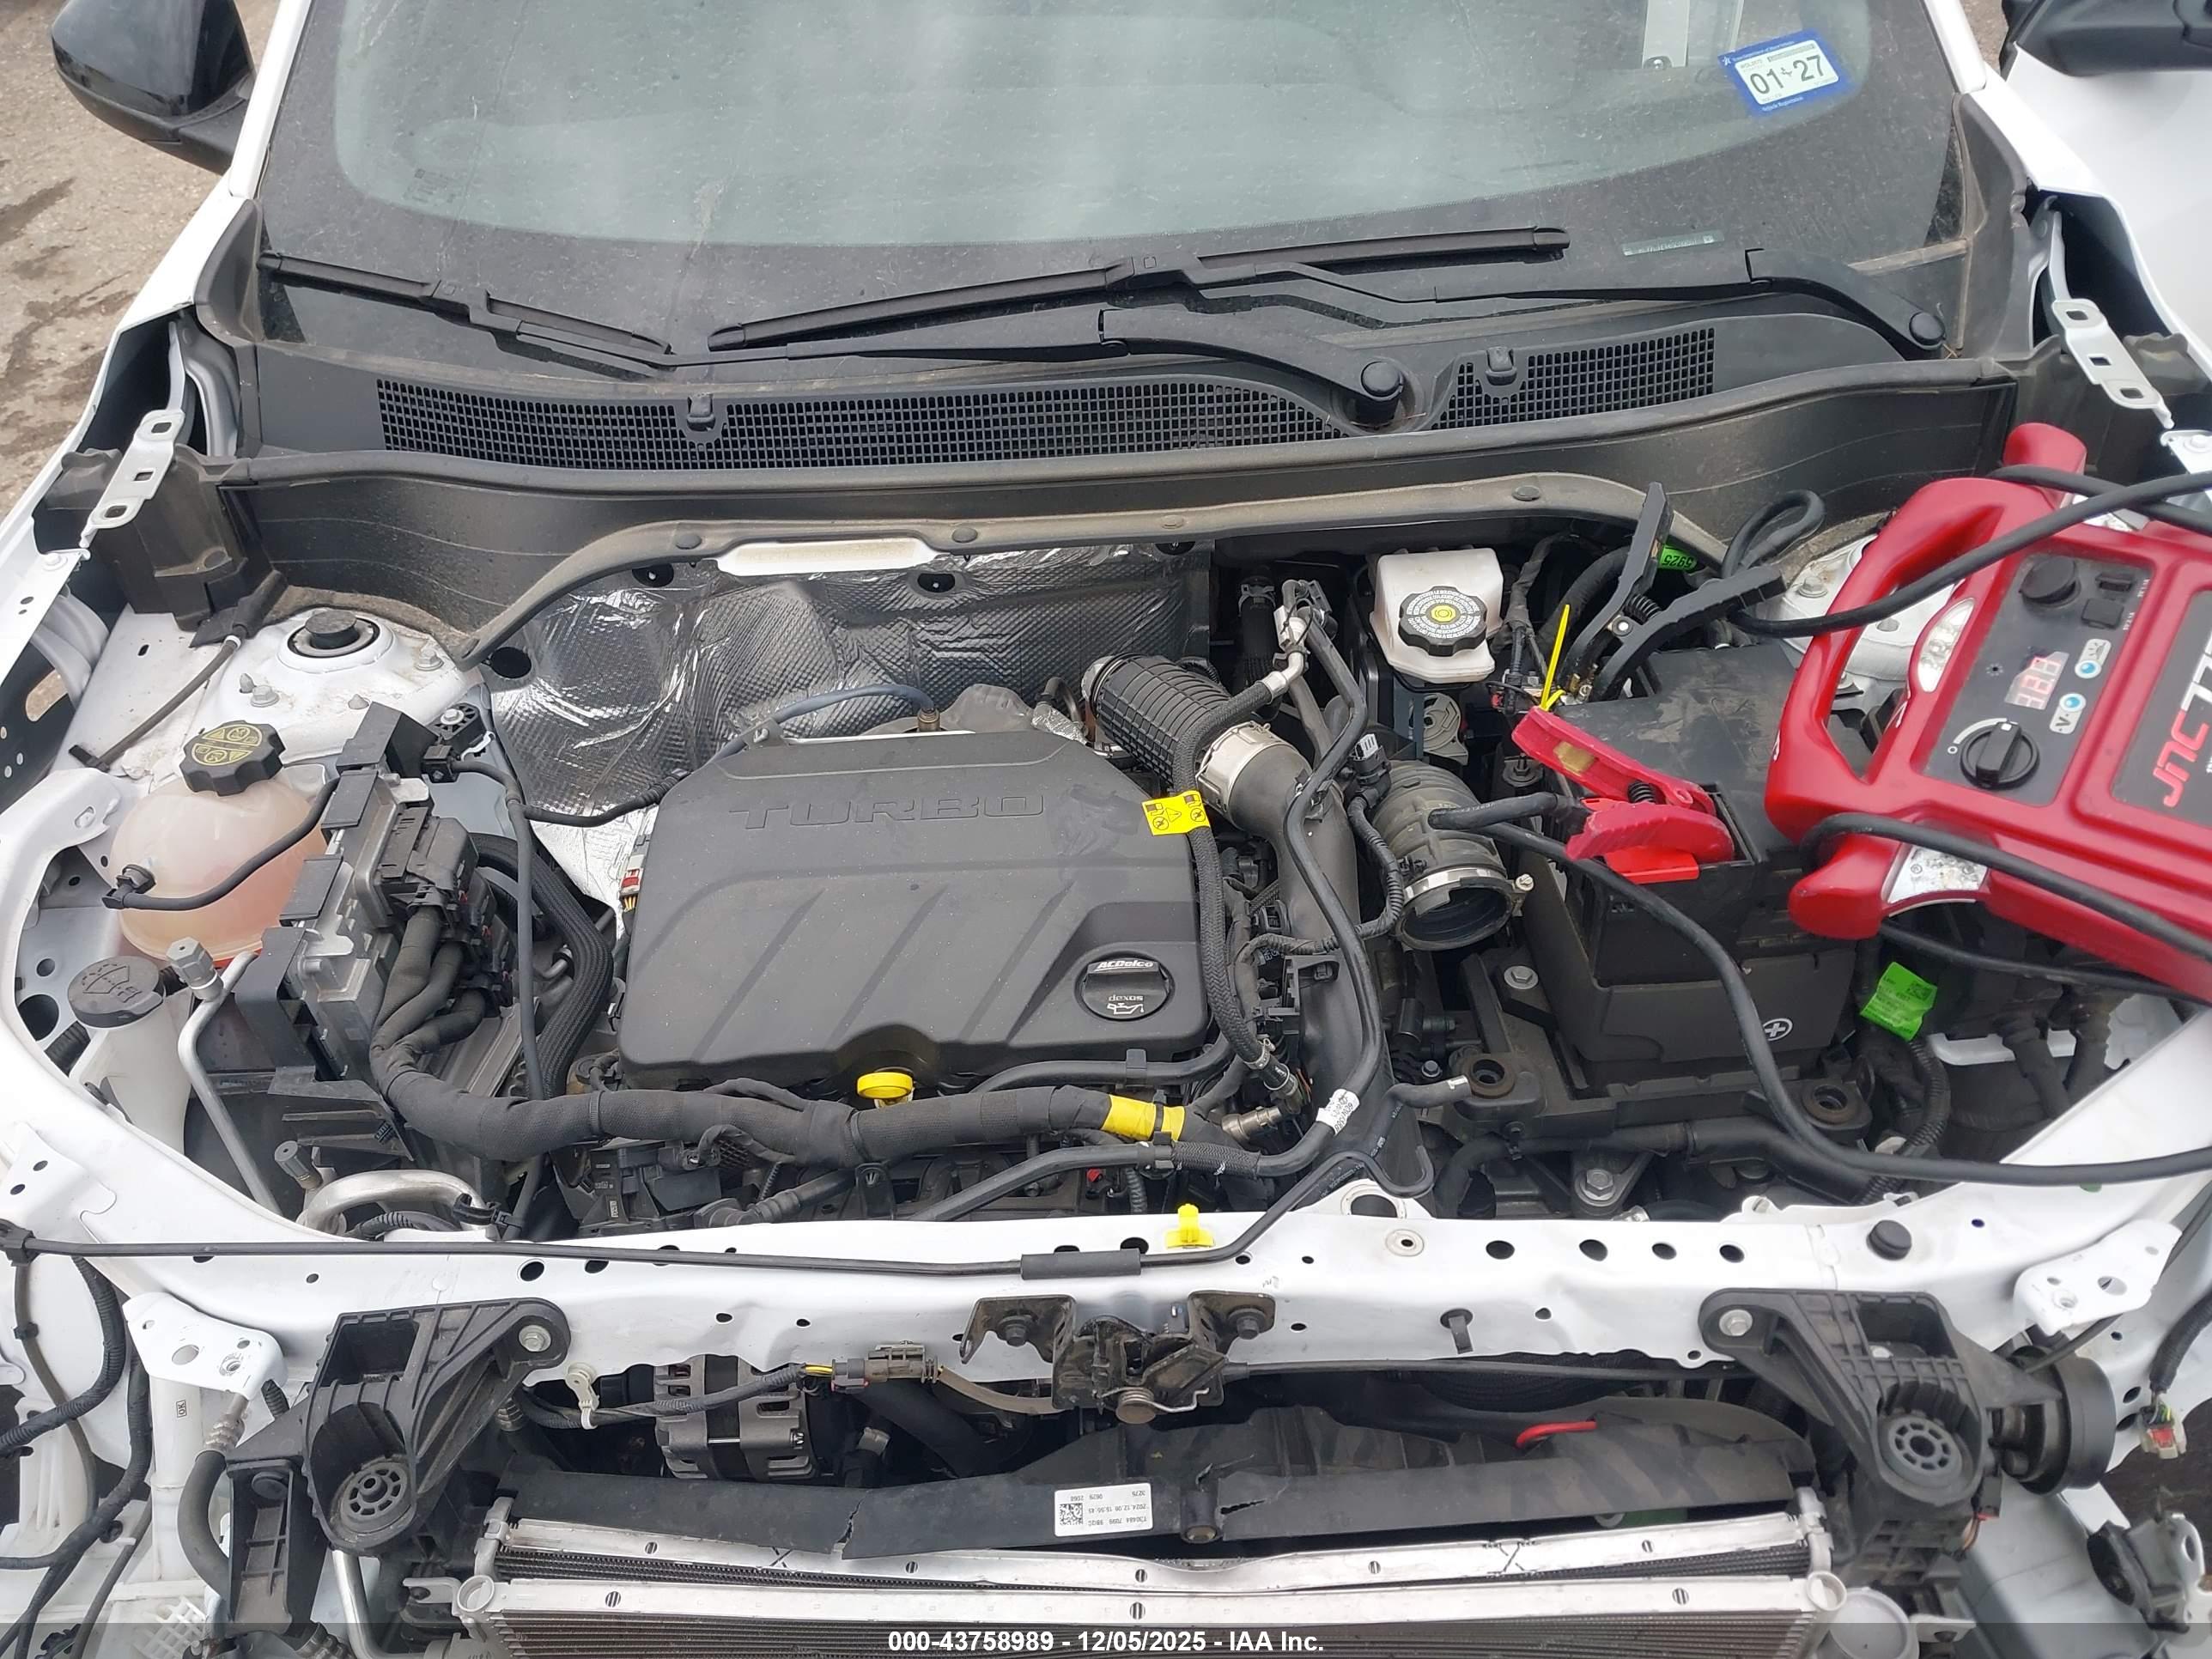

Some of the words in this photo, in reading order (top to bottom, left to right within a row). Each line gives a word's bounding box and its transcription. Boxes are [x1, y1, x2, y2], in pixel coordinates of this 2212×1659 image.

[1750, 69, 1784, 94] 01
[1793, 54, 1824, 82] 27
[1662, 555, 1694, 568] 5925
[729, 795, 1044, 830] TURBO
[1095, 960, 1154, 970] ACDelco
[178, 1402, 185, 1415] OK
